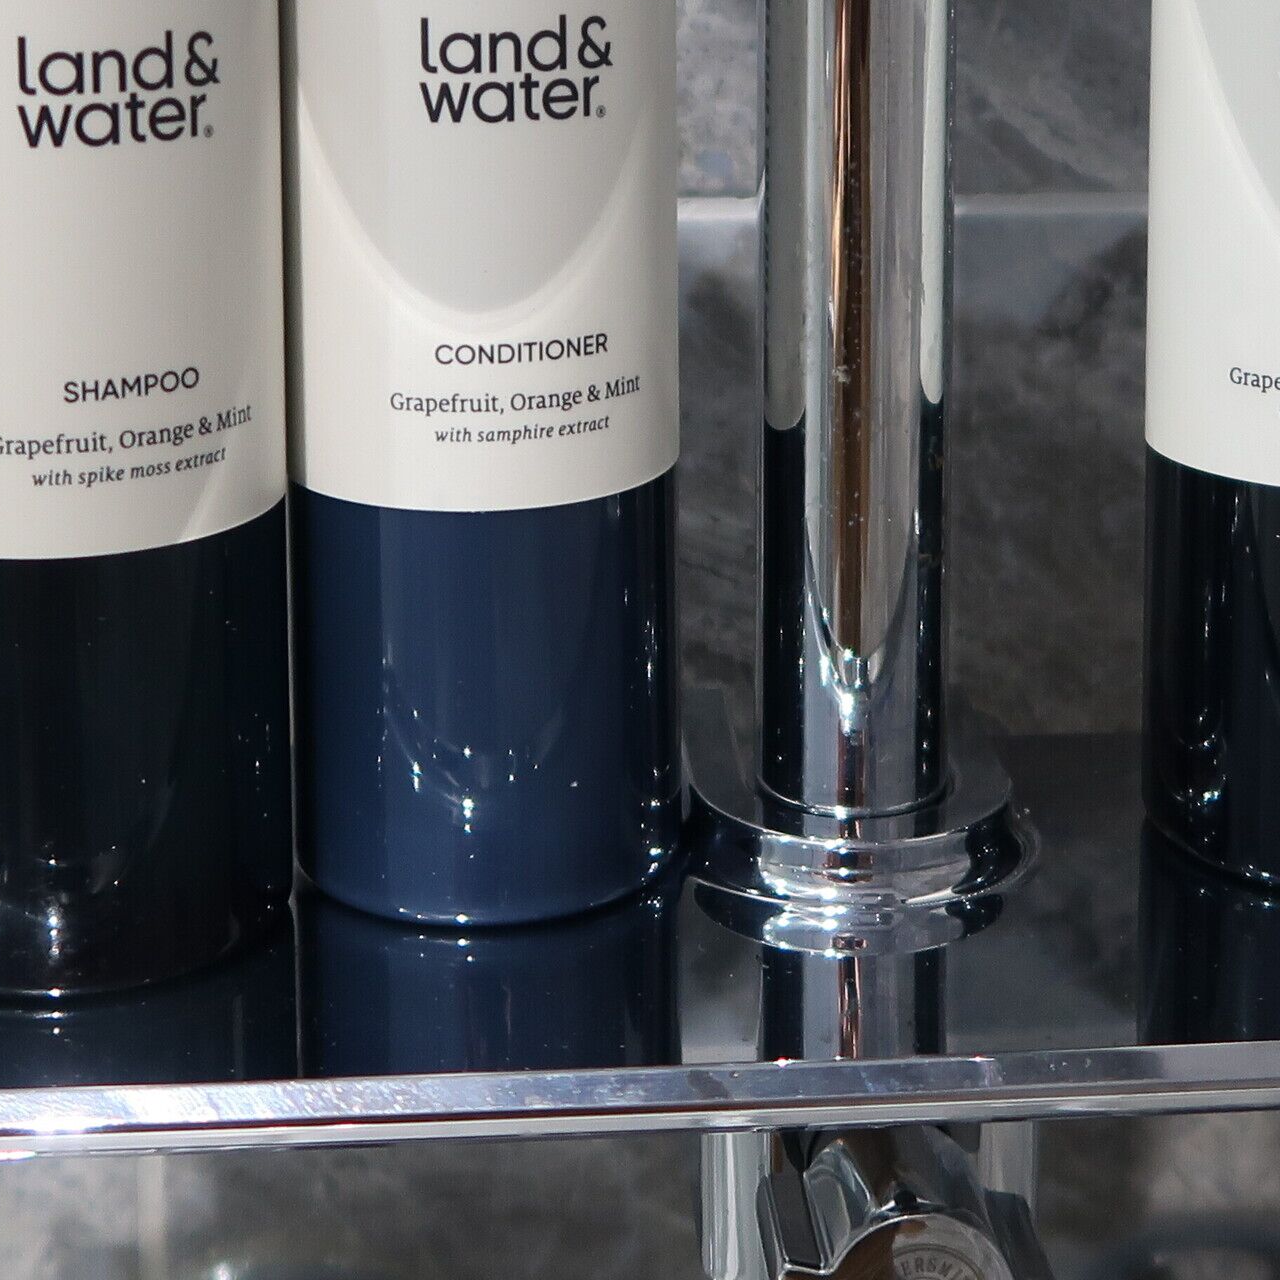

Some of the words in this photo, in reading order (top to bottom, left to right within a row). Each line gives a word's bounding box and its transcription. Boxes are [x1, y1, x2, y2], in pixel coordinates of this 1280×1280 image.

[434, 332, 609, 365] CONDITIONER
[63, 366, 200, 403] SHAMPOO
[389, 392, 505, 417] Grapefruit,
[510, 389, 583, 412] Orange
[587, 384, 601, 402] &
[604, 375, 641, 400] Mint
[119, 420, 194, 450] Orange
[198, 416, 213, 436] &
[216, 404, 253, 433] Mint
[434, 427, 471, 443] with
[477, 423, 554, 445] samphire
[558, 415, 610, 437] extract
[31, 469, 73, 487] with
[77, 464, 125, 488] spike
[130, 460, 171, 480] moss
[174, 446, 227, 472] extract
